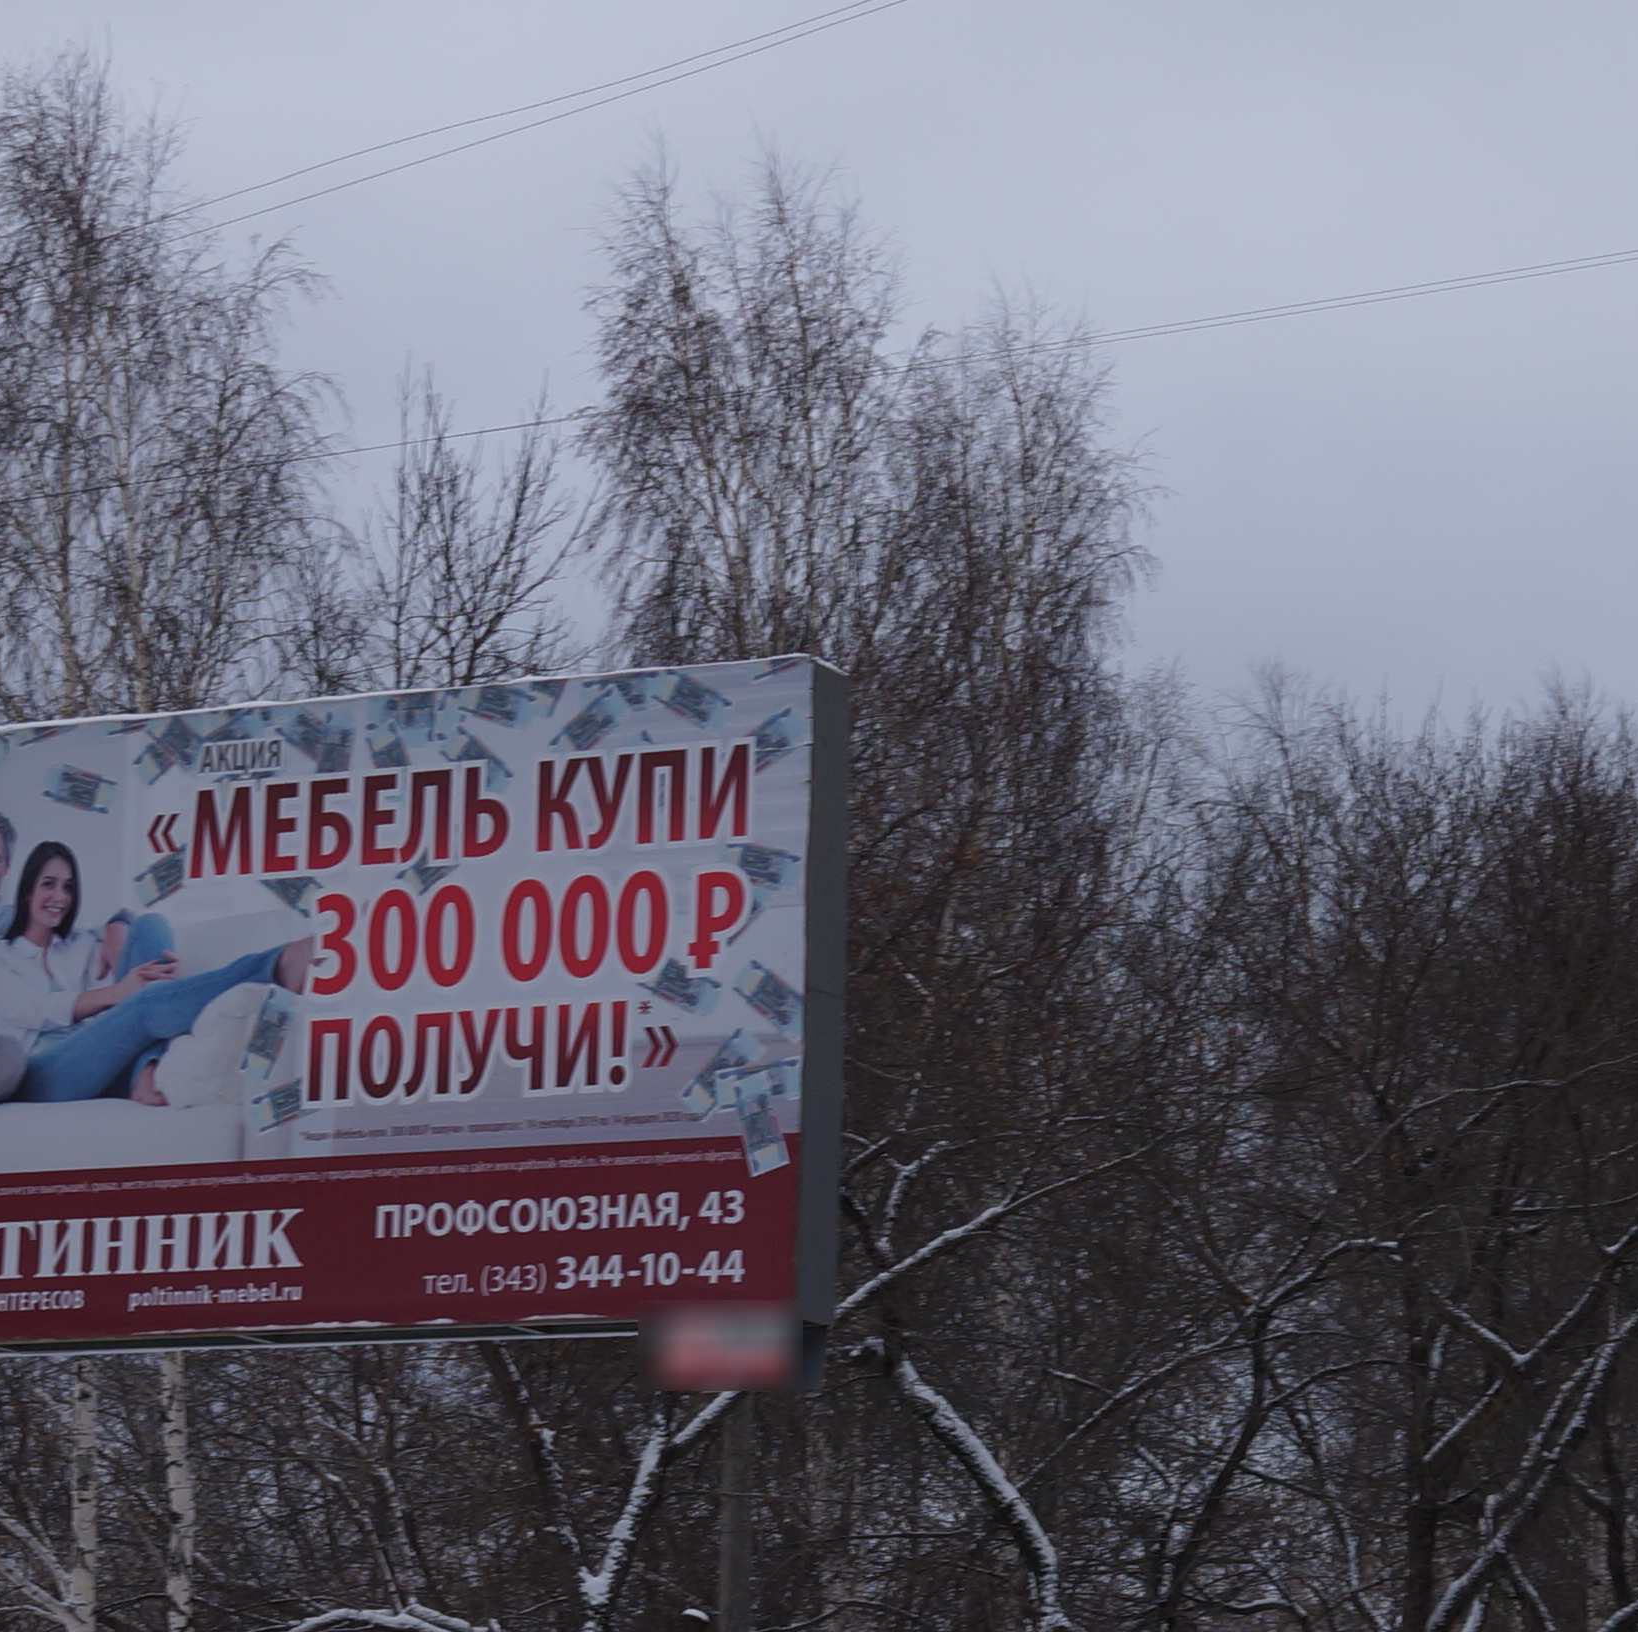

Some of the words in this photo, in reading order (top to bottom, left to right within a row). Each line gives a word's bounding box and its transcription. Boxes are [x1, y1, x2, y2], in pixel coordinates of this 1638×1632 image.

[201, 740, 283, 777] АКЦИЯ
[147, 767, 510, 879] «МЕБЕЛЬ
[536, 744, 751, 852] КУПИ
[311, 884, 475, 995] 300
[501, 870, 668, 982] 000
[375, 1191, 691, 1238] ПРОФСОЮЗНАЯ,
[698, 1189, 746, 1225] 43
[127, 1281, 304, 1311] poltinnik-mebel.ru
[423, 1272, 474, 1295] тел.
[480, 1263, 548, 1297] (343)
[555, 1249, 746, 1290] 344-10-44
